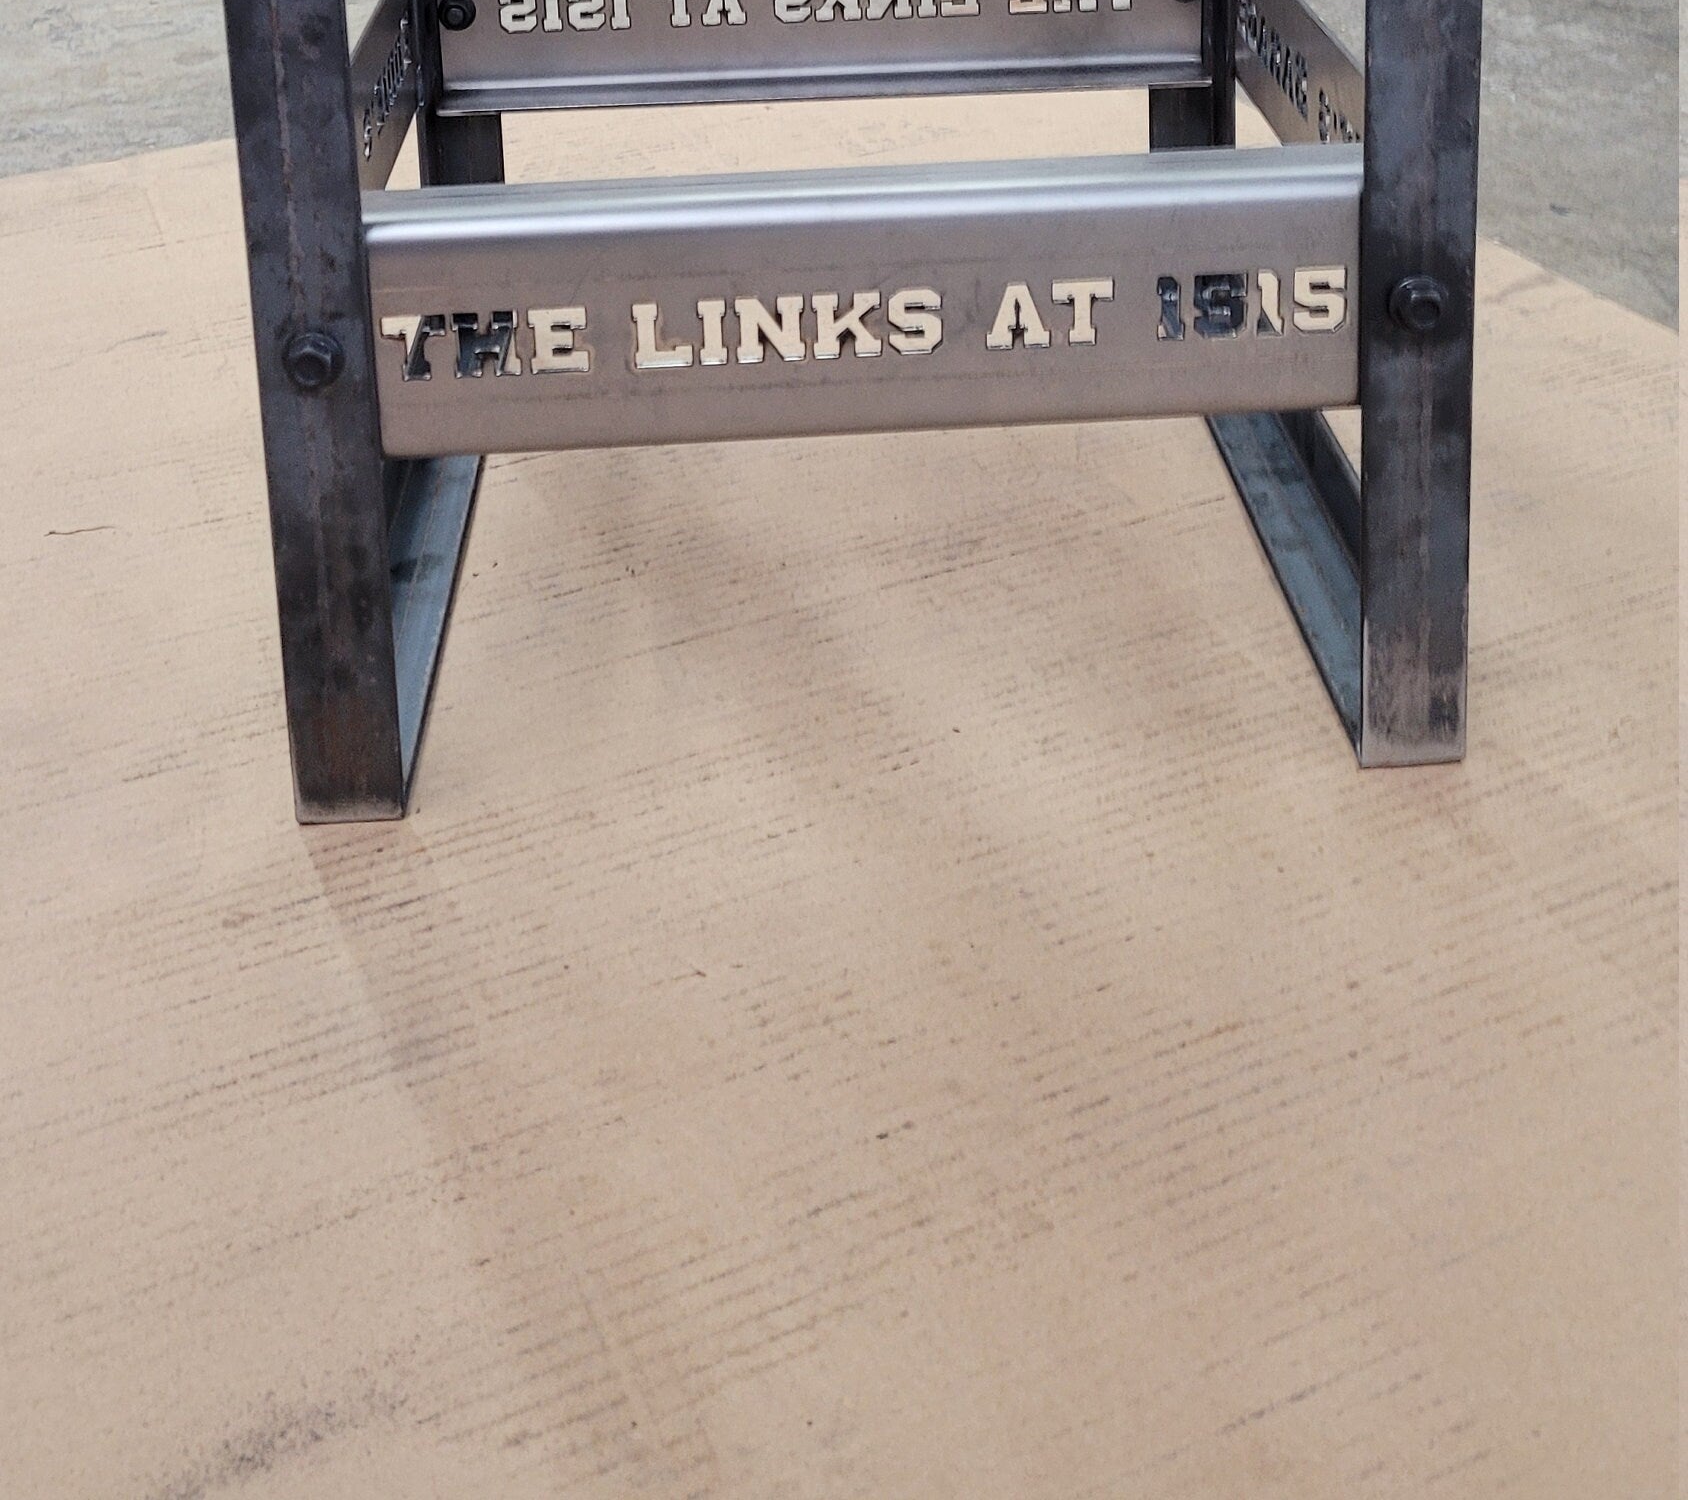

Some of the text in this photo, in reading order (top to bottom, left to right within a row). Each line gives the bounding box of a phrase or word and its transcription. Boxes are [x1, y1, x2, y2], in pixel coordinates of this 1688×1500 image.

[380, 264, 1347, 382] THE LINKS AT 1515
